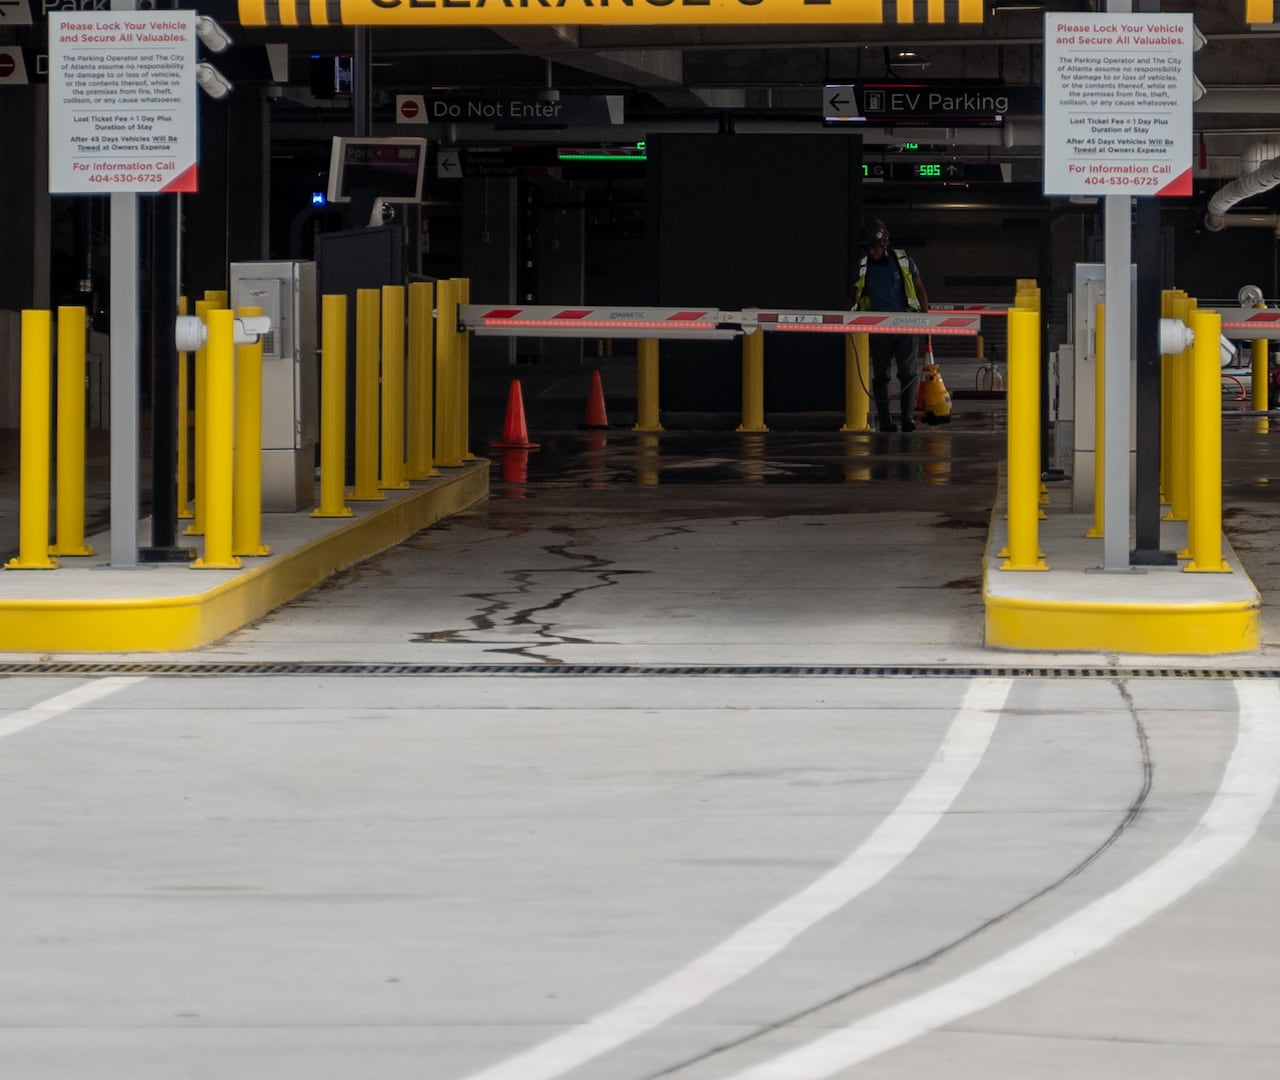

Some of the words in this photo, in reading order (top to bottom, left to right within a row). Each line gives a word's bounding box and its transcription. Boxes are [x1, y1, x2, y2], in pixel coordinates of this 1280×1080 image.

[60, 22, 93, 30] Please
[96, 22, 120, 30] Lock
[123, 22, 146, 30] Your
[150, 22, 187, 30] Vehicle
[1057, 24, 1090, 32] Please
[1093, 24, 1117, 32] Lock
[59, 34, 78, 42] and
[81, 34, 116, 42] Secure
[1056, 36, 1075, 44] and
[1078, 36, 1113, 44] Secure
[1116, 36, 1130, 44] All
[1133, 36, 1185, 45] Valuables.
[891, 93, 922, 111] EV
[928, 92, 1010, 114] Parking
[433, 101, 462, 117] Do
[467, 101, 503, 117] Not
[510, 101, 562, 117] Enter
[73, 163, 90, 171] For
[93, 162, 153, 170] Information
[155, 162, 175, 170] Call
[1069, 165, 1087, 173] For
[1089, 165, 1149, 173] Information
[1152, 165, 1171, 173] Call
[88, 174, 162, 182] 404-530-6725
[1084, 177, 1159, 185] 404-530-6725
